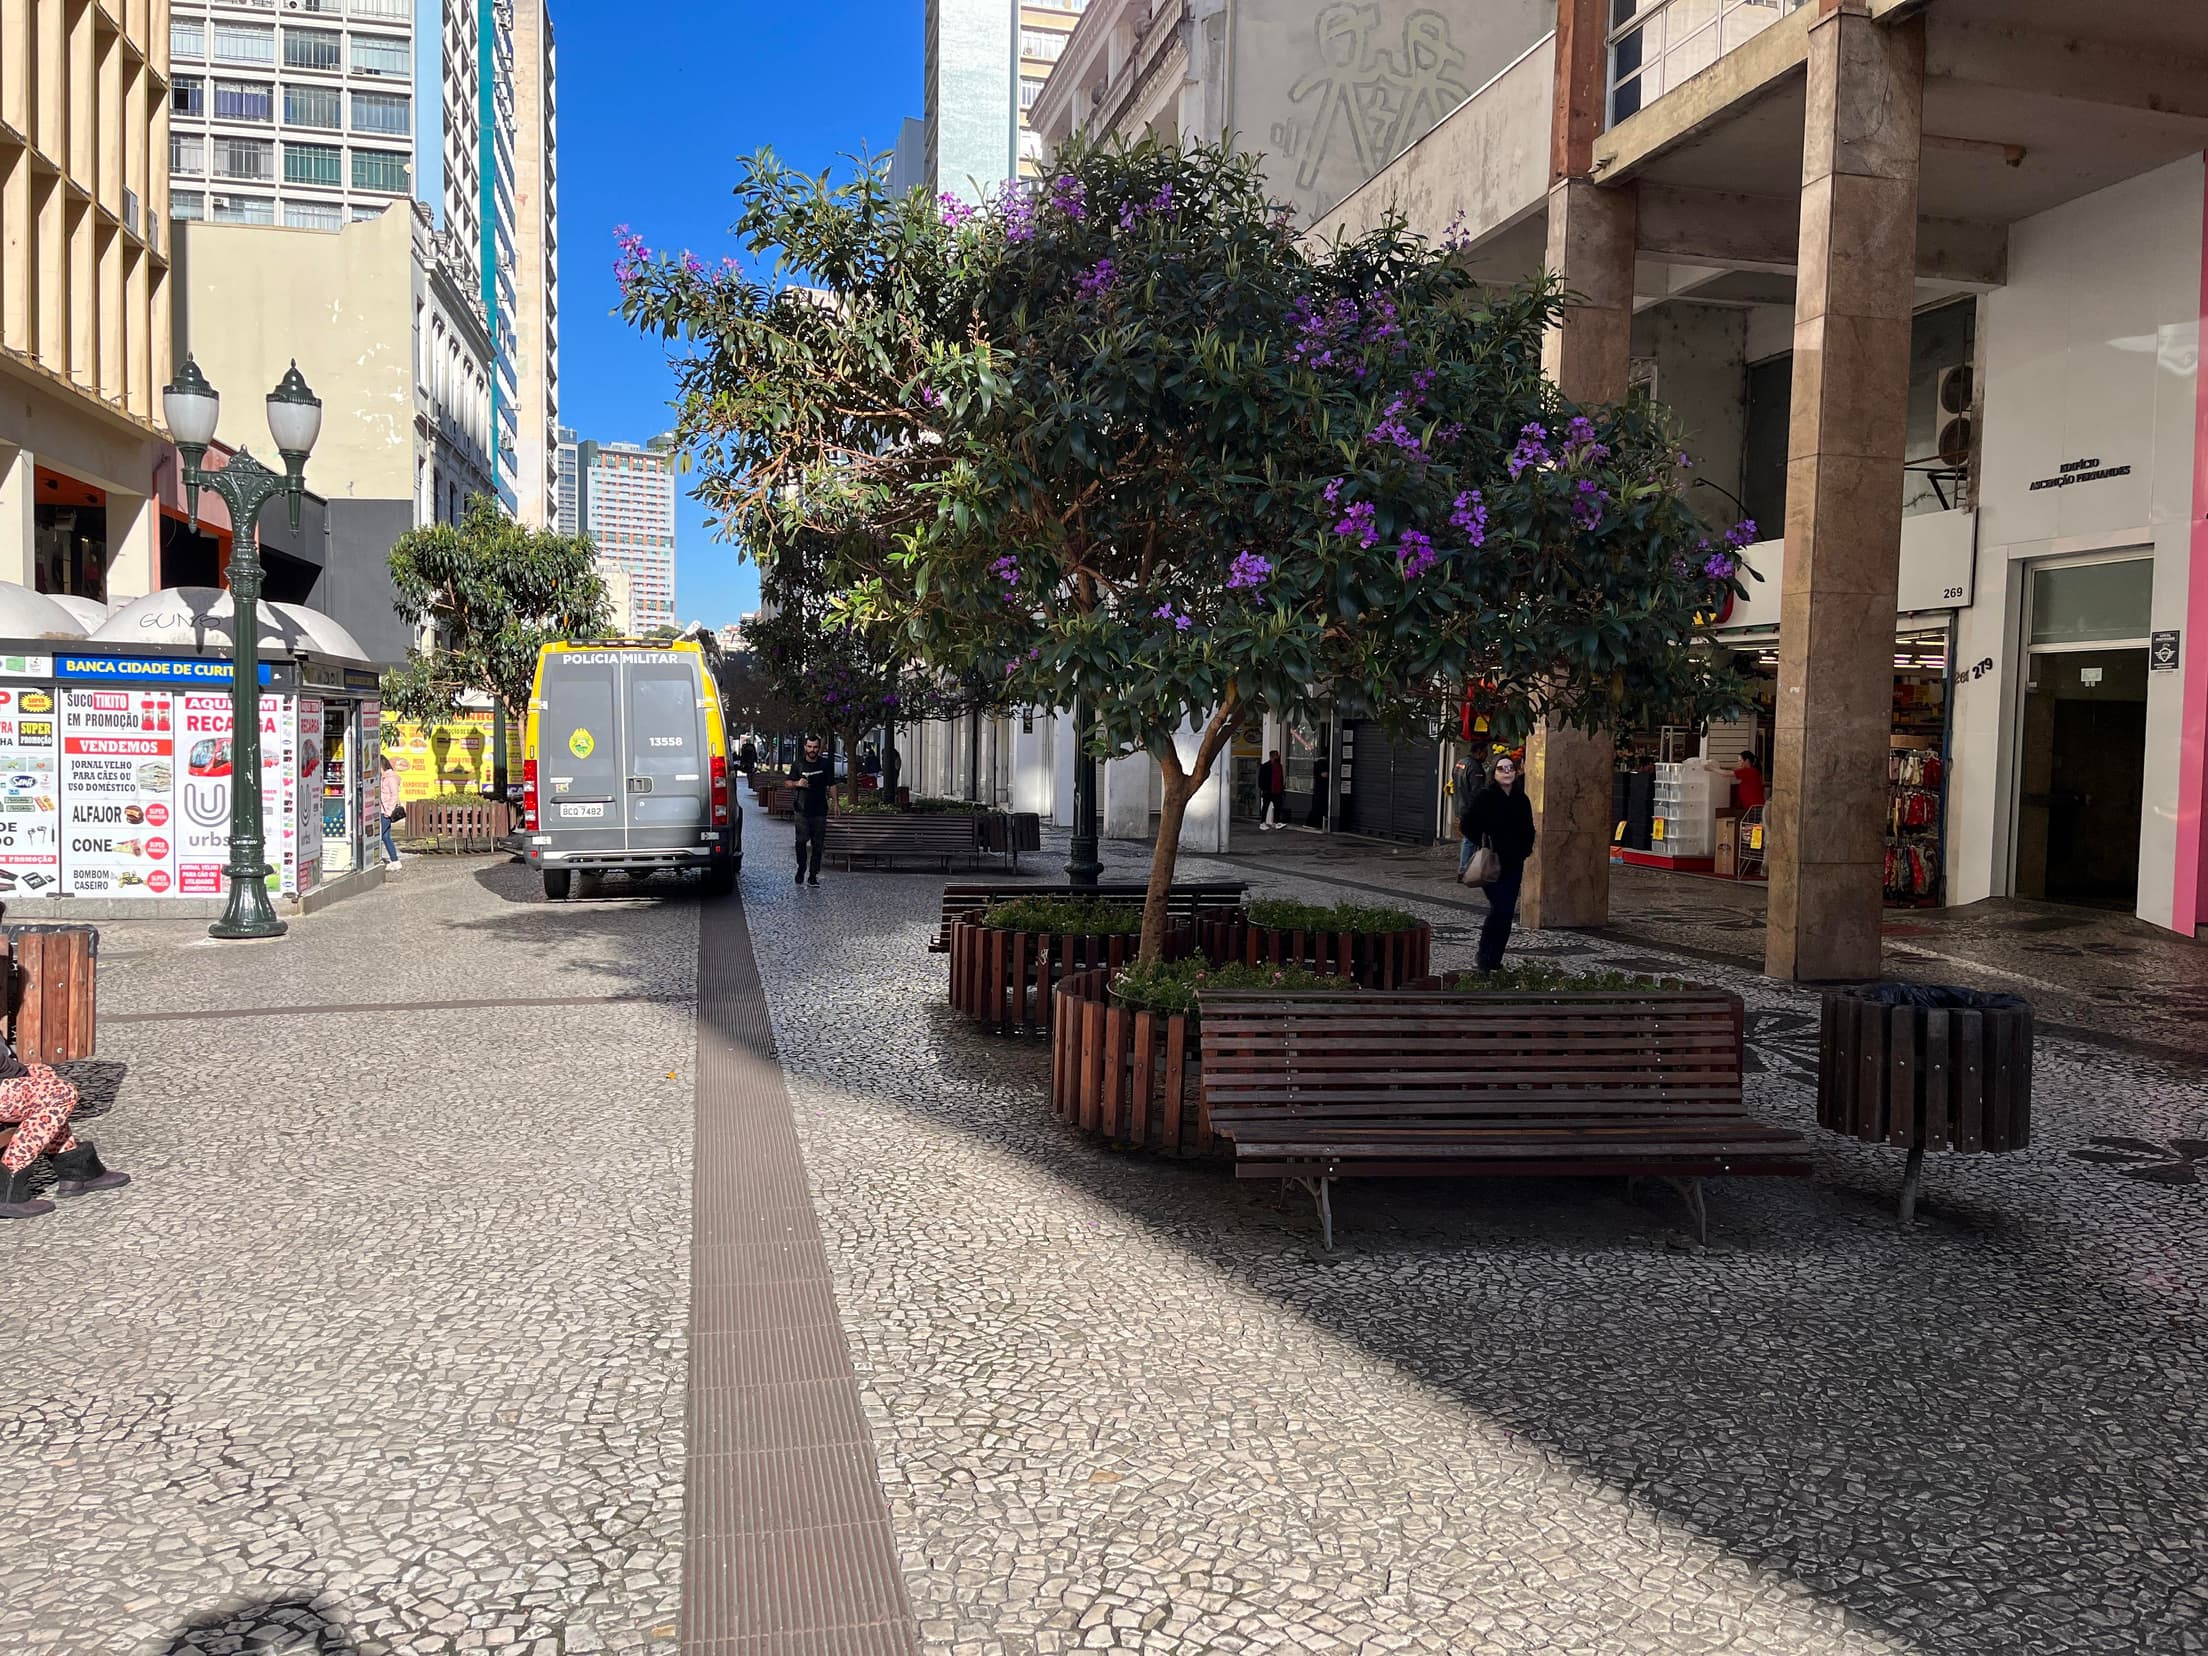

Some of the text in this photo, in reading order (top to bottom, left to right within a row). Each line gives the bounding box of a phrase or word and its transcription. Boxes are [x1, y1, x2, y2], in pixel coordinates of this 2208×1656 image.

[2060, 458, 2100, 473] EDIFÍCIO
[2076, 465, 2131, 483] FERNANDES
[1943, 587, 1963, 599] 269
[563, 653, 678, 664] POLÍCIA MILITAR
[66, 660, 235, 677] BANCA CIDADE DE CURIT
[1972, 657, 1993, 679] 279
[67, 694, 127, 709] SUCO TIKITO
[67, 712, 139, 730] EM PROMOÇÃO
[187, 715, 276, 733] RECAA
[21, 722, 51, 734] SUPER
[80, 740, 158, 753] VENDEMOS
[649, 737, 683, 747] 13558
[71, 760, 132, 770] JORNAL VELHO
[73, 770, 131, 781] PARA CÃES OU
[67, 781, 136, 792] USO DOMÉSTICO
[72, 805, 122, 823] ALFAJOR
[72, 838, 113, 852] CONE
[189, 831, 230, 847] urbs
[73, 870, 109, 879] BOMBOM
[74, 881, 109, 890] CASEIRO
